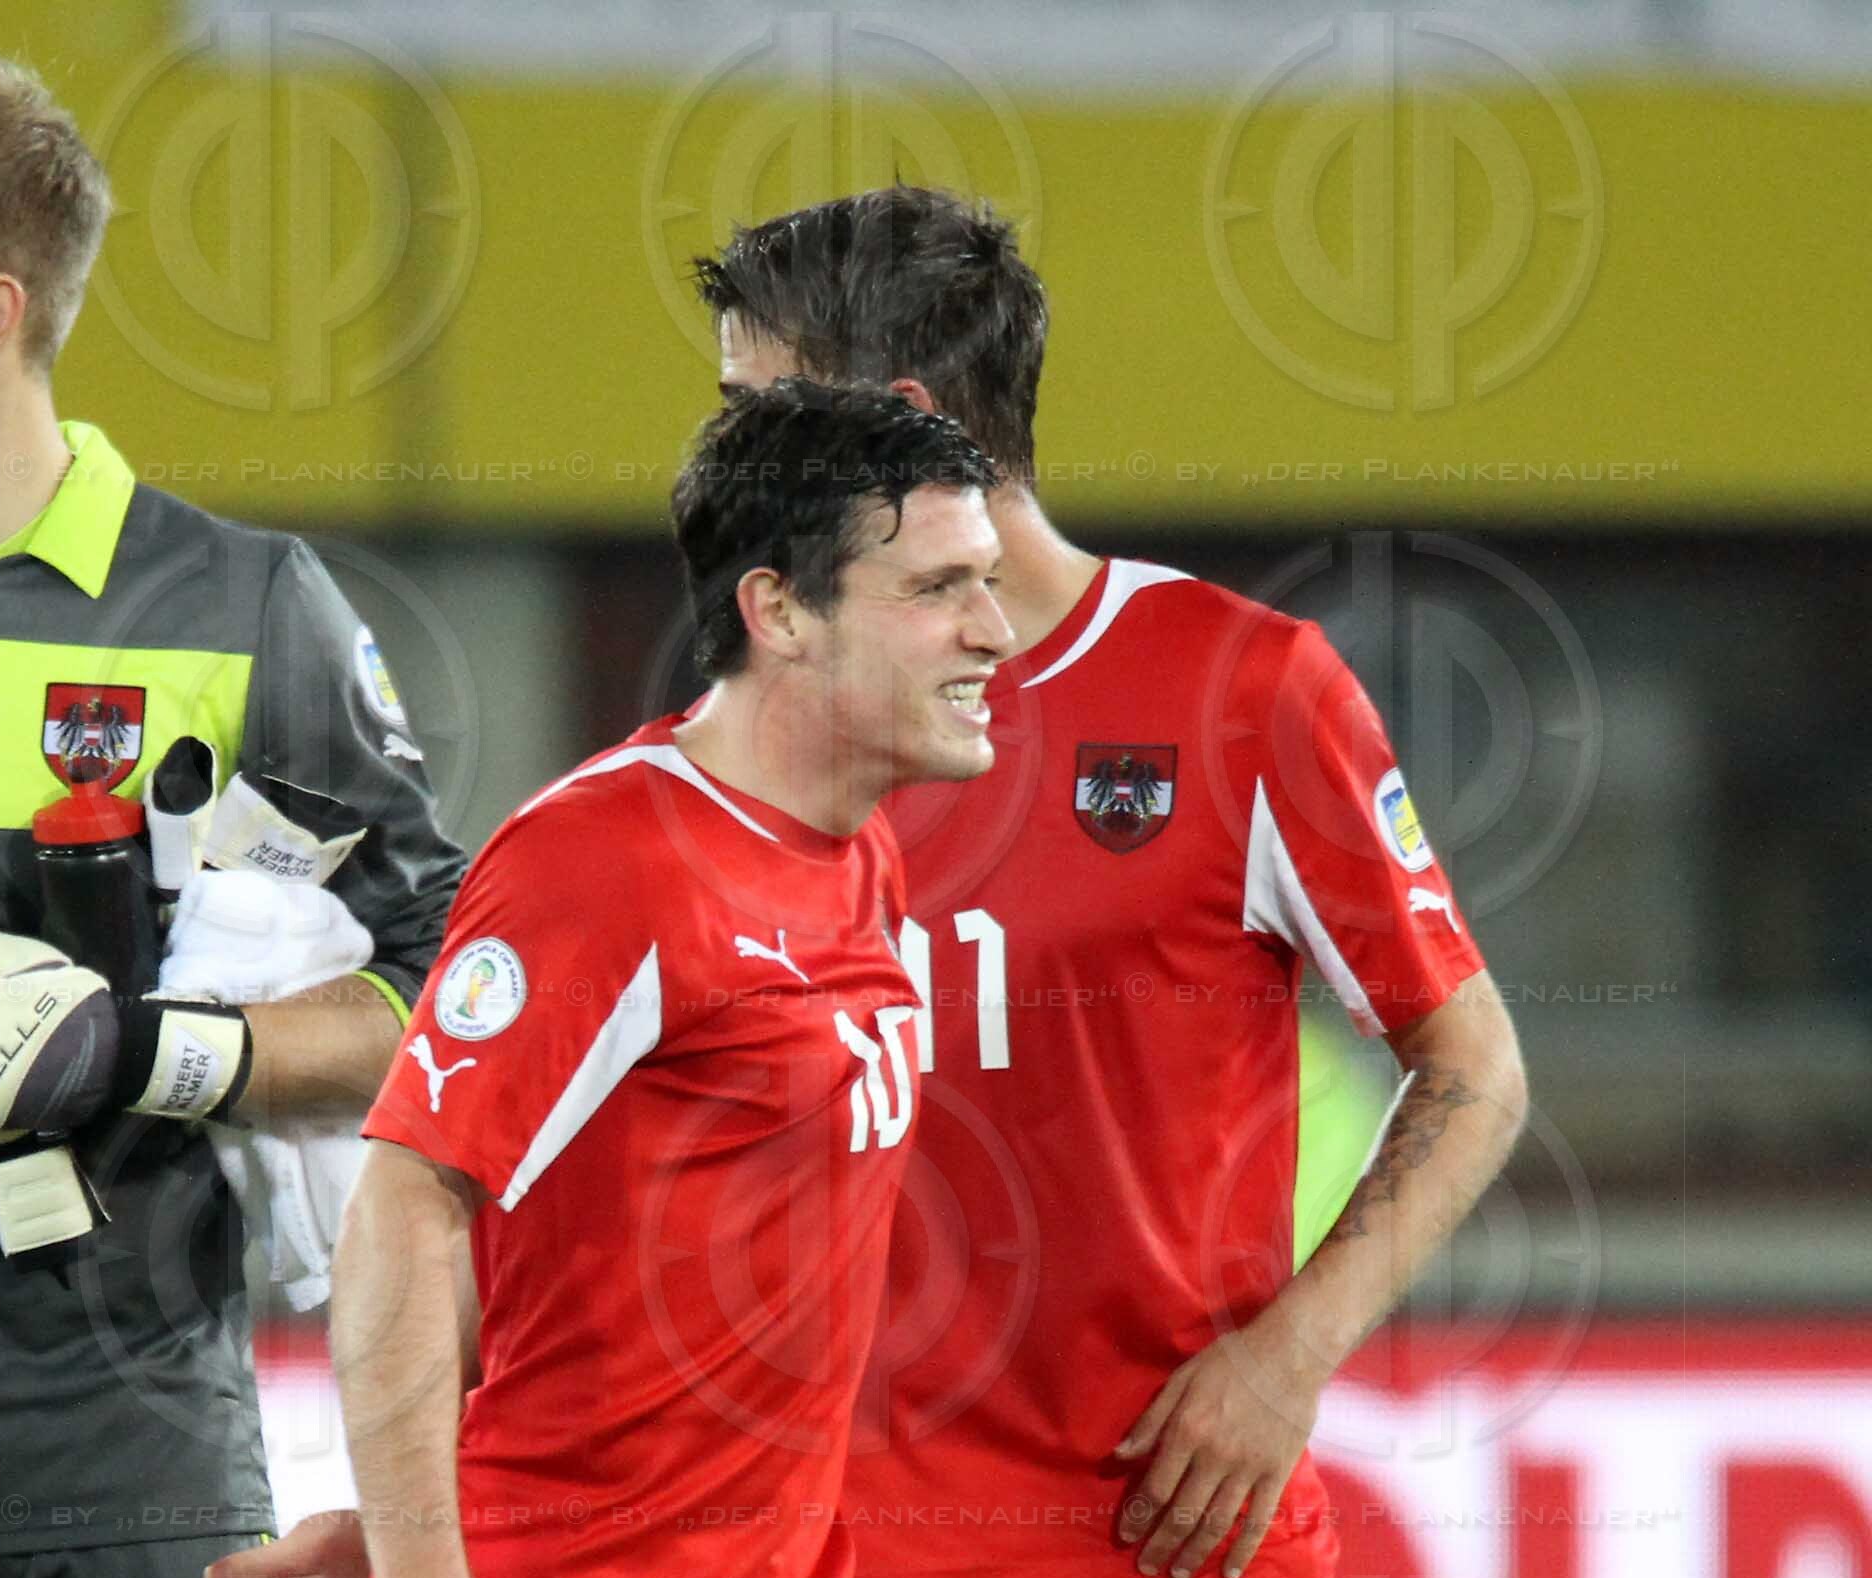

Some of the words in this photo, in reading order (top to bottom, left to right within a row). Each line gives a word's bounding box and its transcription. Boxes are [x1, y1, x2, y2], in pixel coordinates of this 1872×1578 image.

[245, 847, 313, 877] ROBERT
[258, 840, 315, 867] ALMER
[898, 908, 1010, 1074] 11
[832, 1004, 913, 1153] 10
